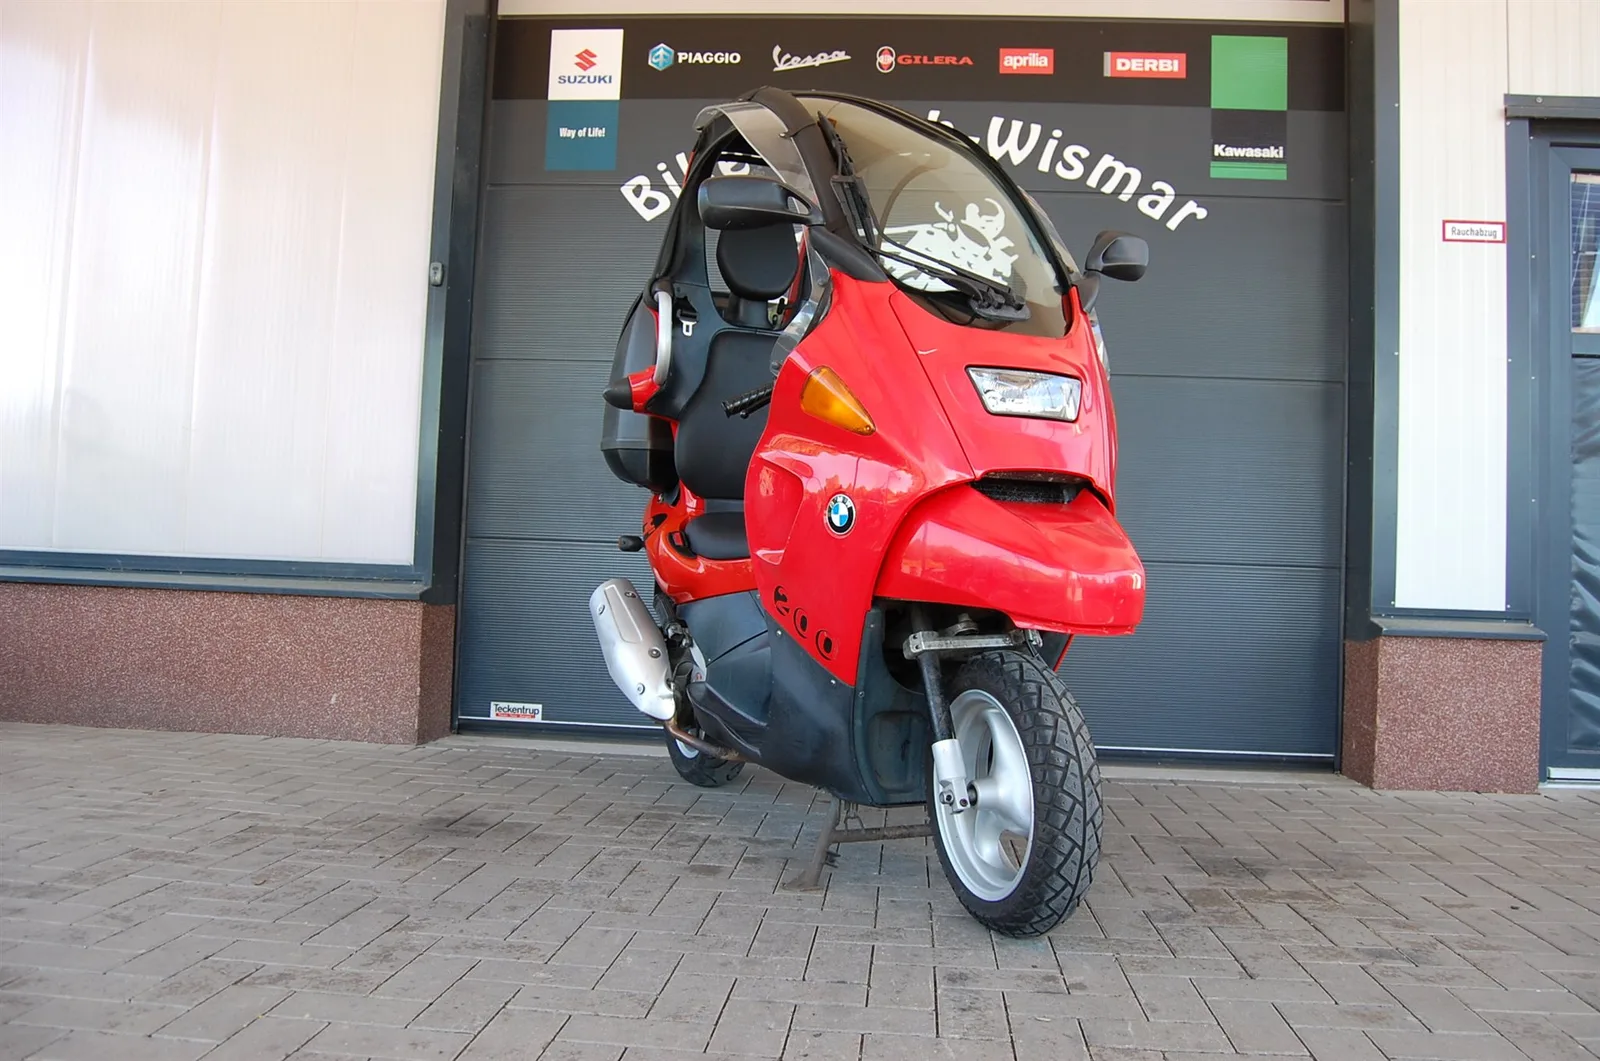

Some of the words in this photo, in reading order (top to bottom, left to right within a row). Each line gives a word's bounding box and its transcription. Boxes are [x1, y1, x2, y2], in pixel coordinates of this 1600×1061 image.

[677, 52, 741, 64] PIAGGIO
[772, 45, 850, 71] Vespa
[897, 55, 973, 66] GILERA
[1003, 52, 1048, 70] aprilia
[1116, 58, 1179, 72] DERBI
[557, 75, 613, 84] SUZUKI
[559, 127, 576, 139] Way
[577, 127, 587, 137] of
[588, 127, 606, 137] Life!
[1213, 144, 1284, 158] Kawasaki
[1450, 226, 1498, 239] Rauchabzug
[493, 703, 540, 717] Teckentrup
